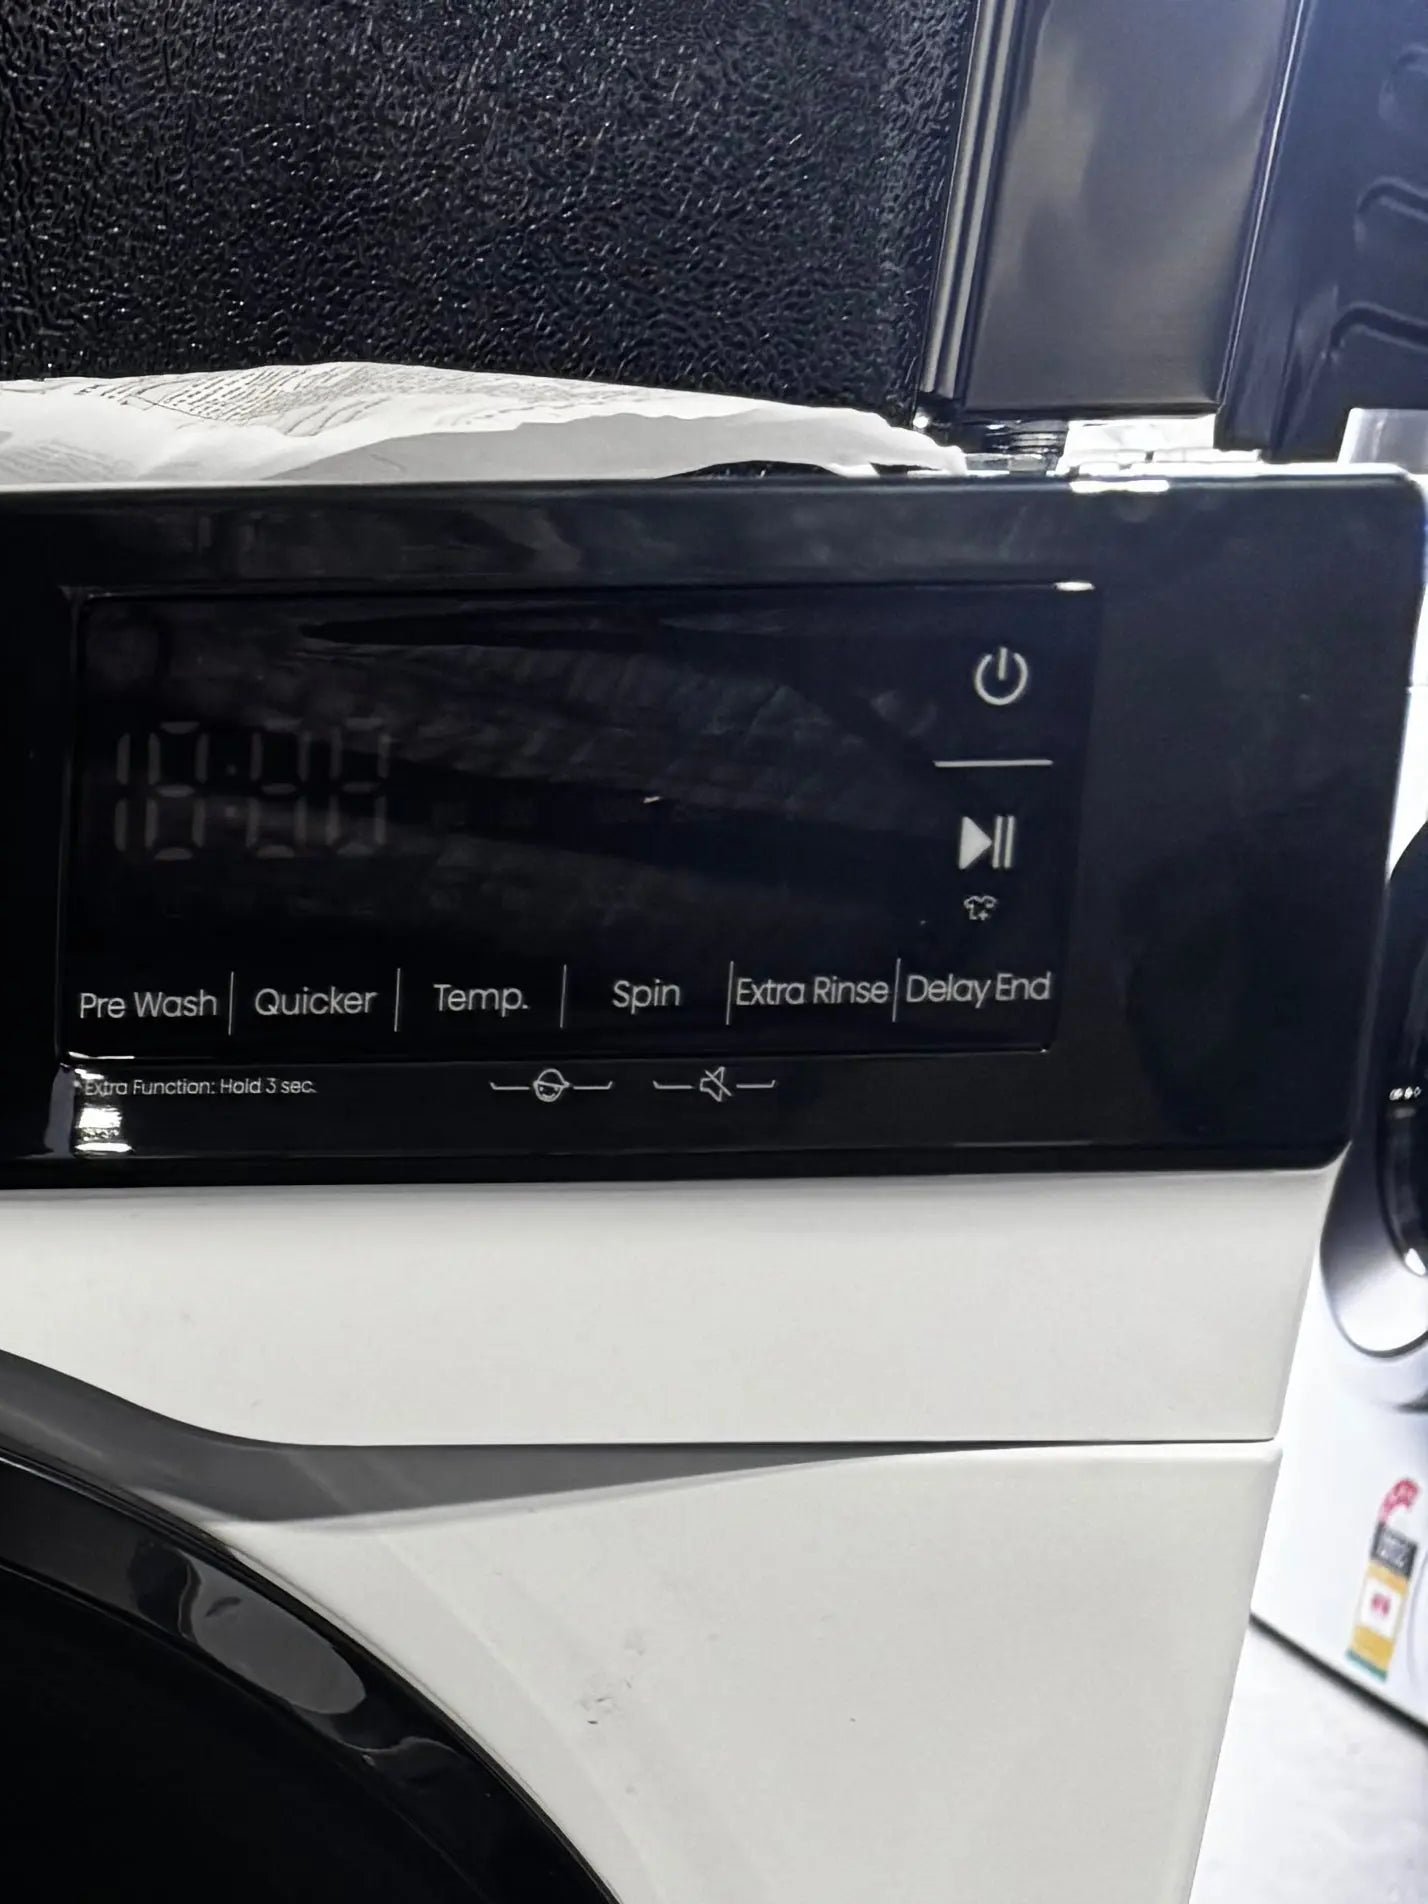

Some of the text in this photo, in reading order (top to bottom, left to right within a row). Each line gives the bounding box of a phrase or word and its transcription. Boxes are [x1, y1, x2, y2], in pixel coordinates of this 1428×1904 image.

[80, 989, 217, 1019] Pre Wash
[254, 986, 377, 1017] Quicker
[433, 984, 529, 1018] Temp.
[612, 979, 681, 1015] Spin
[736, 975, 889, 1006] Extra Rinse
[907, 971, 1051, 1008] Delay End
[133, 1077, 216, 1095] Function:
[220, 1077, 262, 1094] Hold
[265, 1077, 277, 1094] 3
